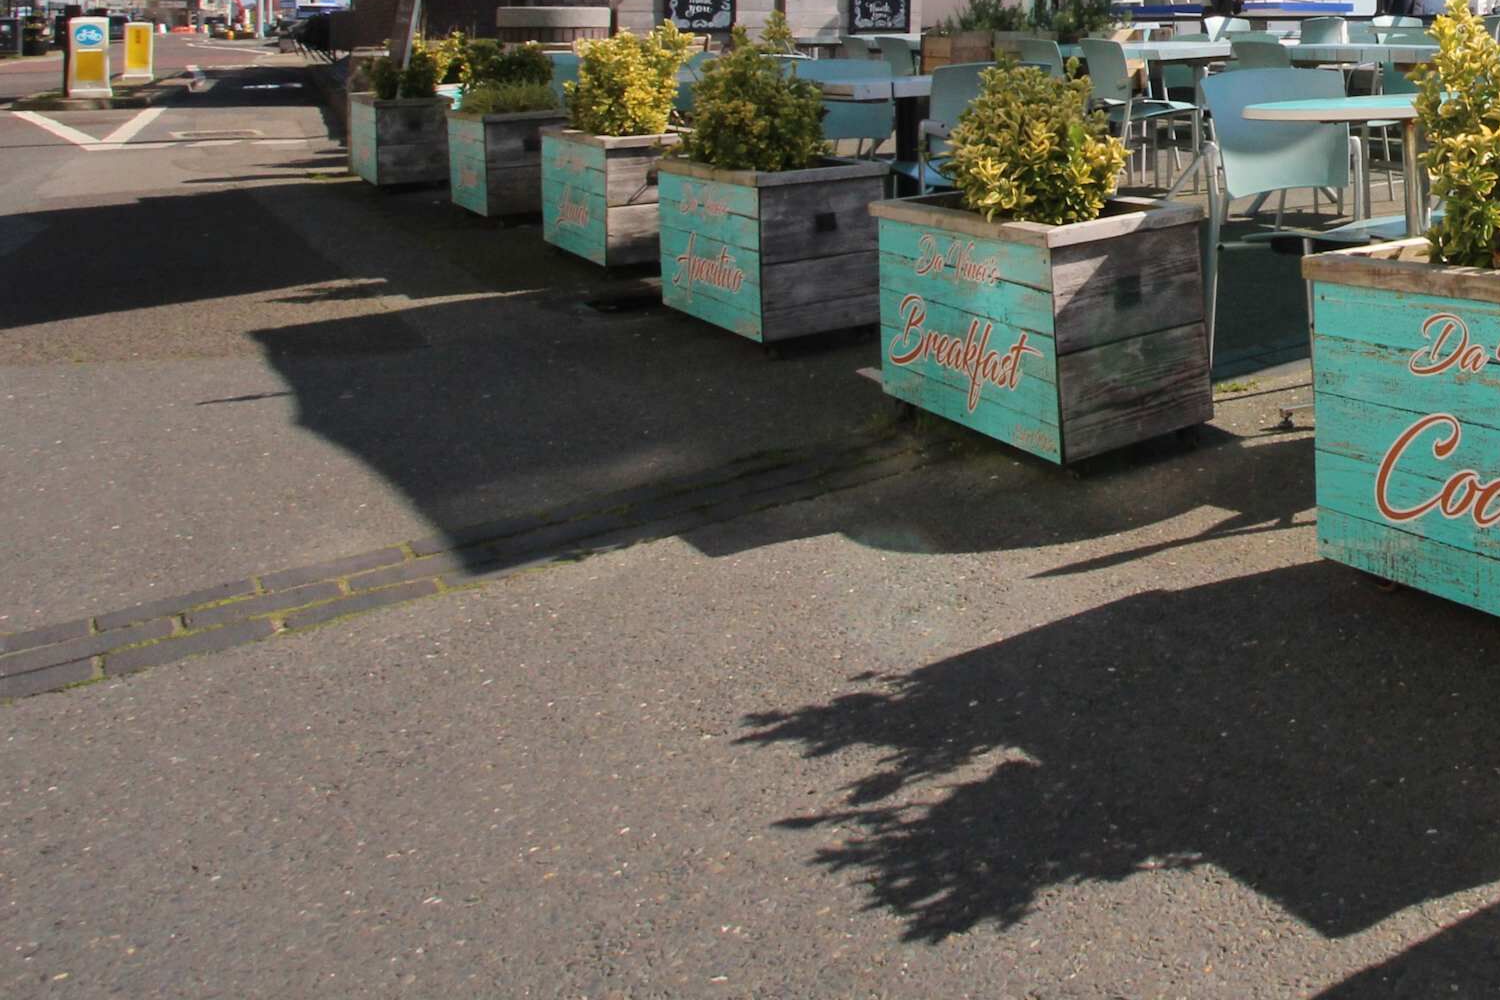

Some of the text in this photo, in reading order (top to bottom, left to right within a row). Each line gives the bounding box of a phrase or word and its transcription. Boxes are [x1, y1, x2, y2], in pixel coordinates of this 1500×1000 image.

[915, 233, 944, 276] Da
[889, 293, 1044, 414] Breakfast
[1408, 312, 1489, 376] Da
